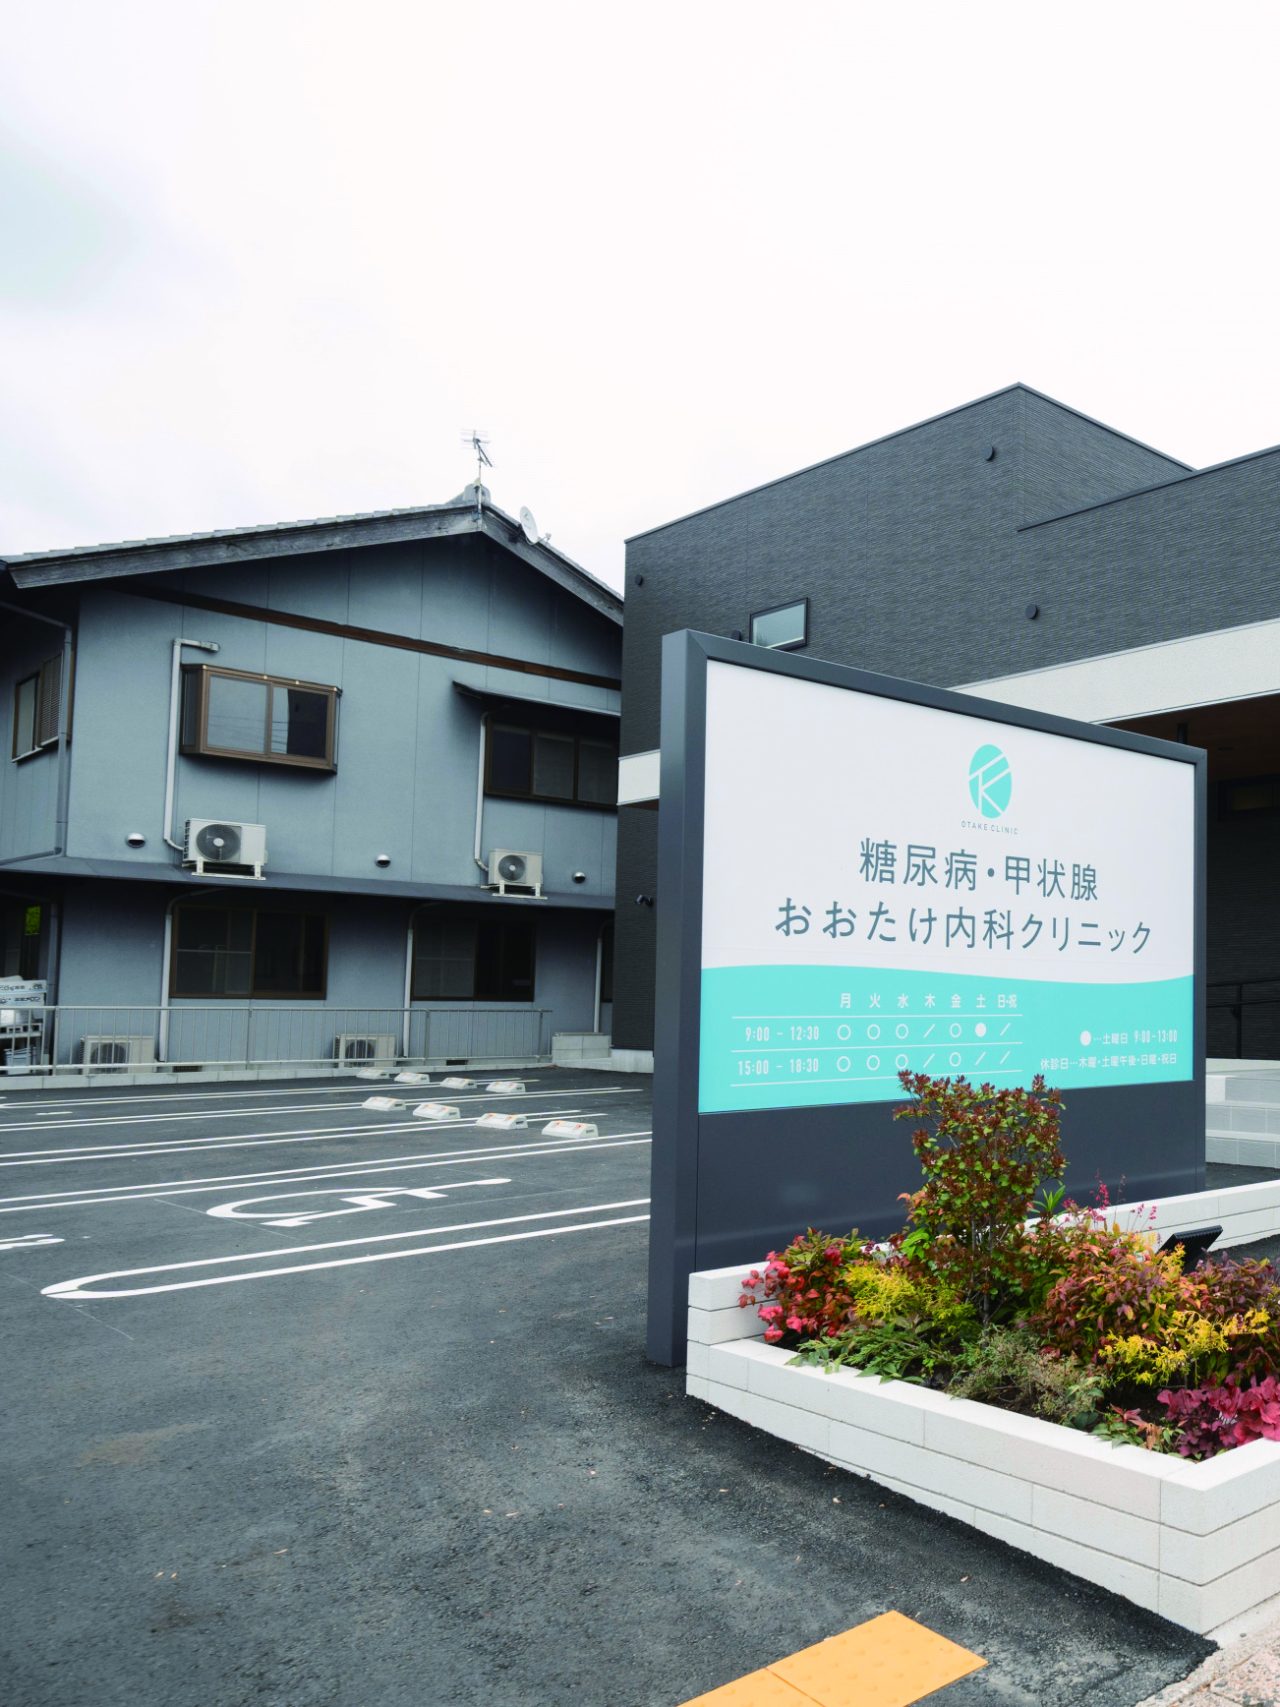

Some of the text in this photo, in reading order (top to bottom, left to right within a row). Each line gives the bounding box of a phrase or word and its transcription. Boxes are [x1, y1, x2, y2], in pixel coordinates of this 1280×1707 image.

[960, 820, 1019, 836] OTAKE CLINIC
[859, 837, 1098, 902] 糖尿病・甲状腺
[775, 897, 1152, 955] おおたけ内科クリニック
[840, 992, 851, 1009] 月
[869, 992, 881, 1009] 火
[897, 992, 909, 1009] 水
[924, 992, 936, 1009] 木
[951, 993, 962, 1009] 金
[975, 993, 986, 1009] 土
[745, 1026, 770, 1042] 9:00
[790, 1025, 820, 1041] 12:30
[738, 1060, 769, 1076] 15:00
